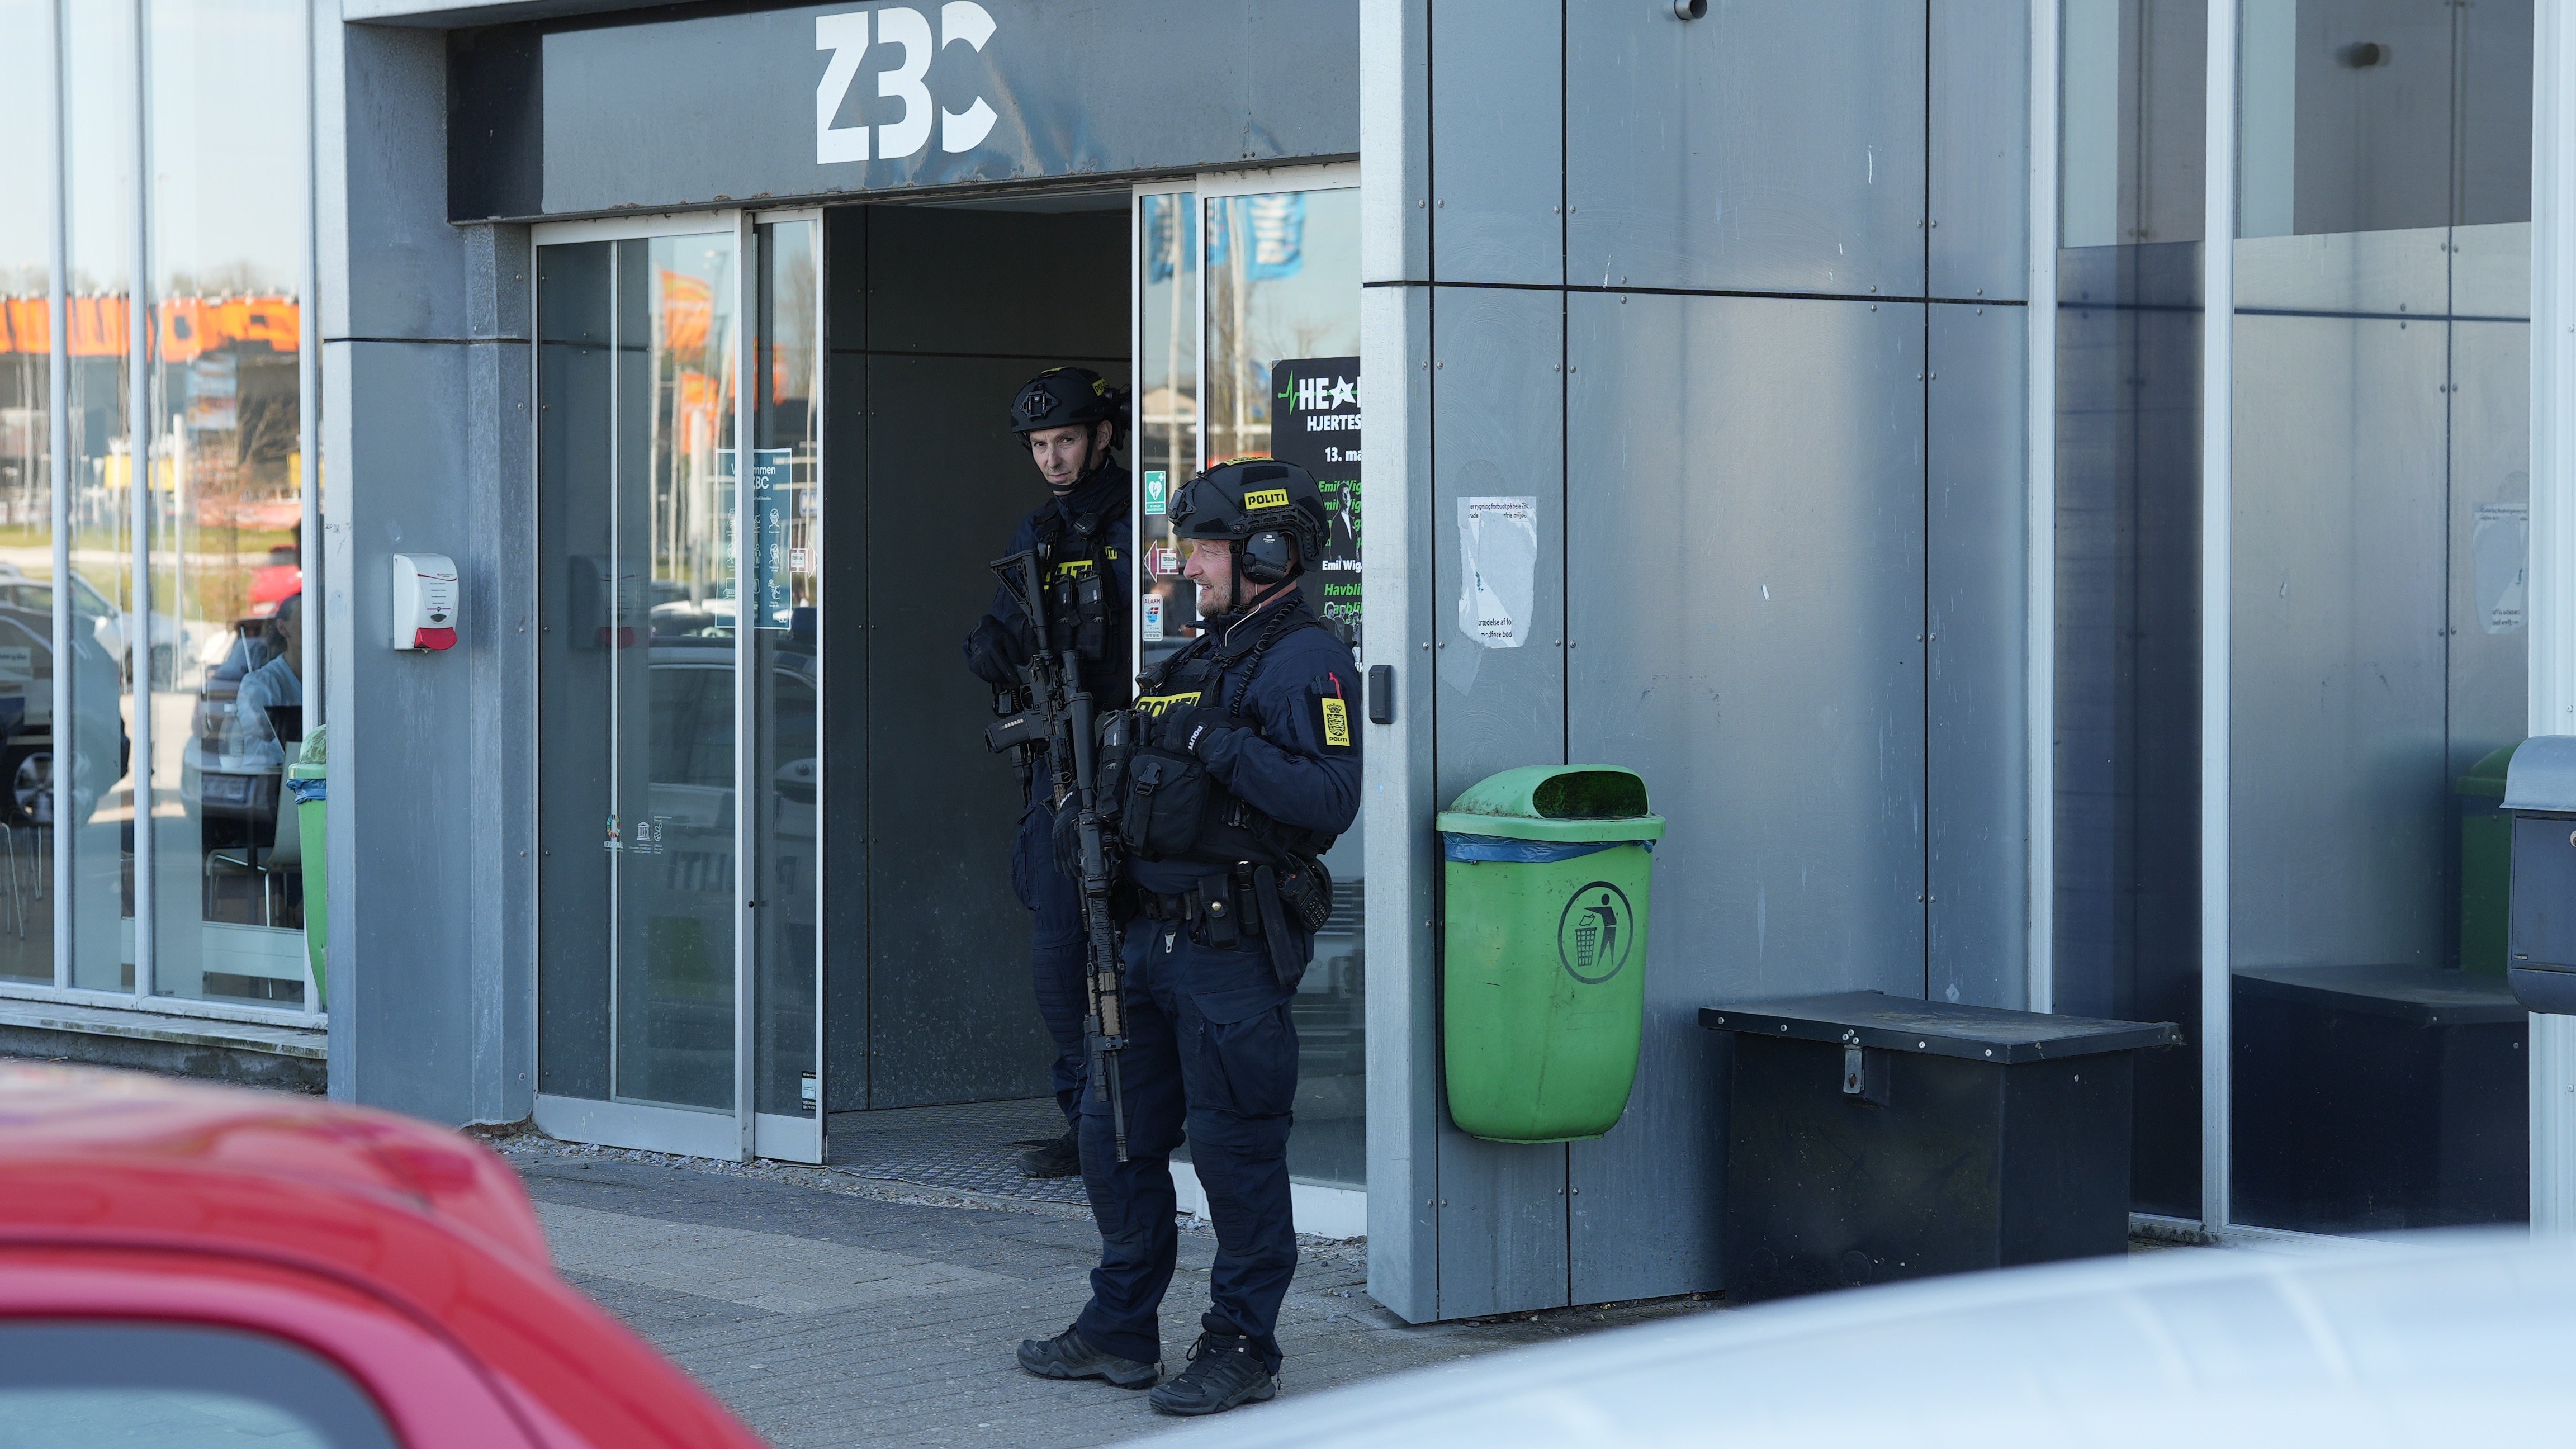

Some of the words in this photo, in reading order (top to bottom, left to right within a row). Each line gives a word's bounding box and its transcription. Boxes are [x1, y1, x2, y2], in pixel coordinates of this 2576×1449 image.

[816, 0, 998, 165] ZBC
[1325, 447, 1342, 462] 13.
[1248, 493, 1285, 506] POLITI
[1322, 561, 1341, 571] Emil
[1343, 561, 1362, 573] Wig
[1324, 583, 1362, 596] Havbli
[1187, 725, 1204, 750] POLITI
